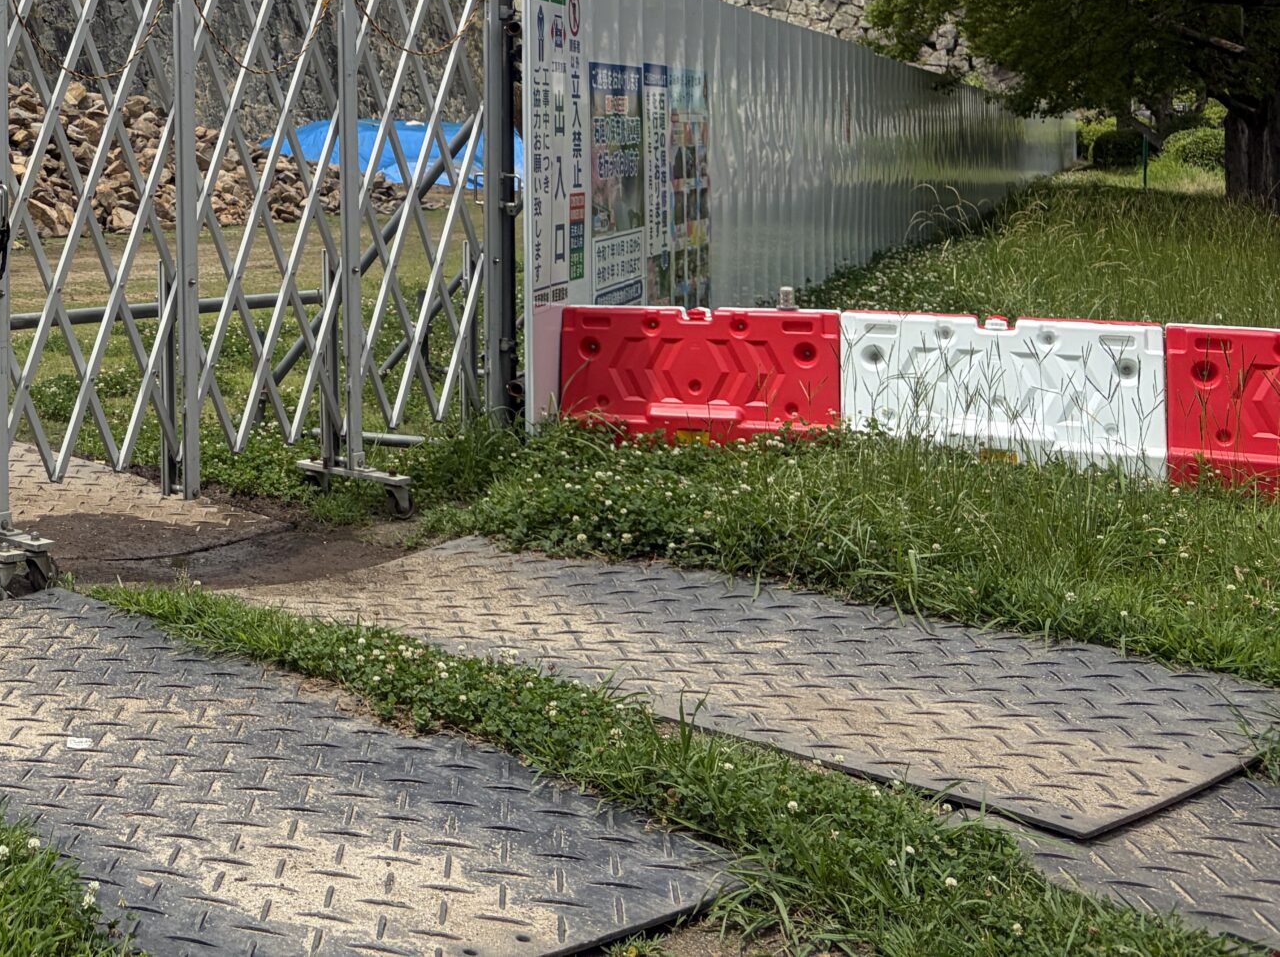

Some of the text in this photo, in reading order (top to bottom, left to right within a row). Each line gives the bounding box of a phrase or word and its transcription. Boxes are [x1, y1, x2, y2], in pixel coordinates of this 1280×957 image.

[533, 66, 542, 283] ご協力お願い致します
[542, 68, 551, 194] 工事中につき
[554, 90, 566, 264] 出入口
[571, 70, 583, 188] 立入禁止
